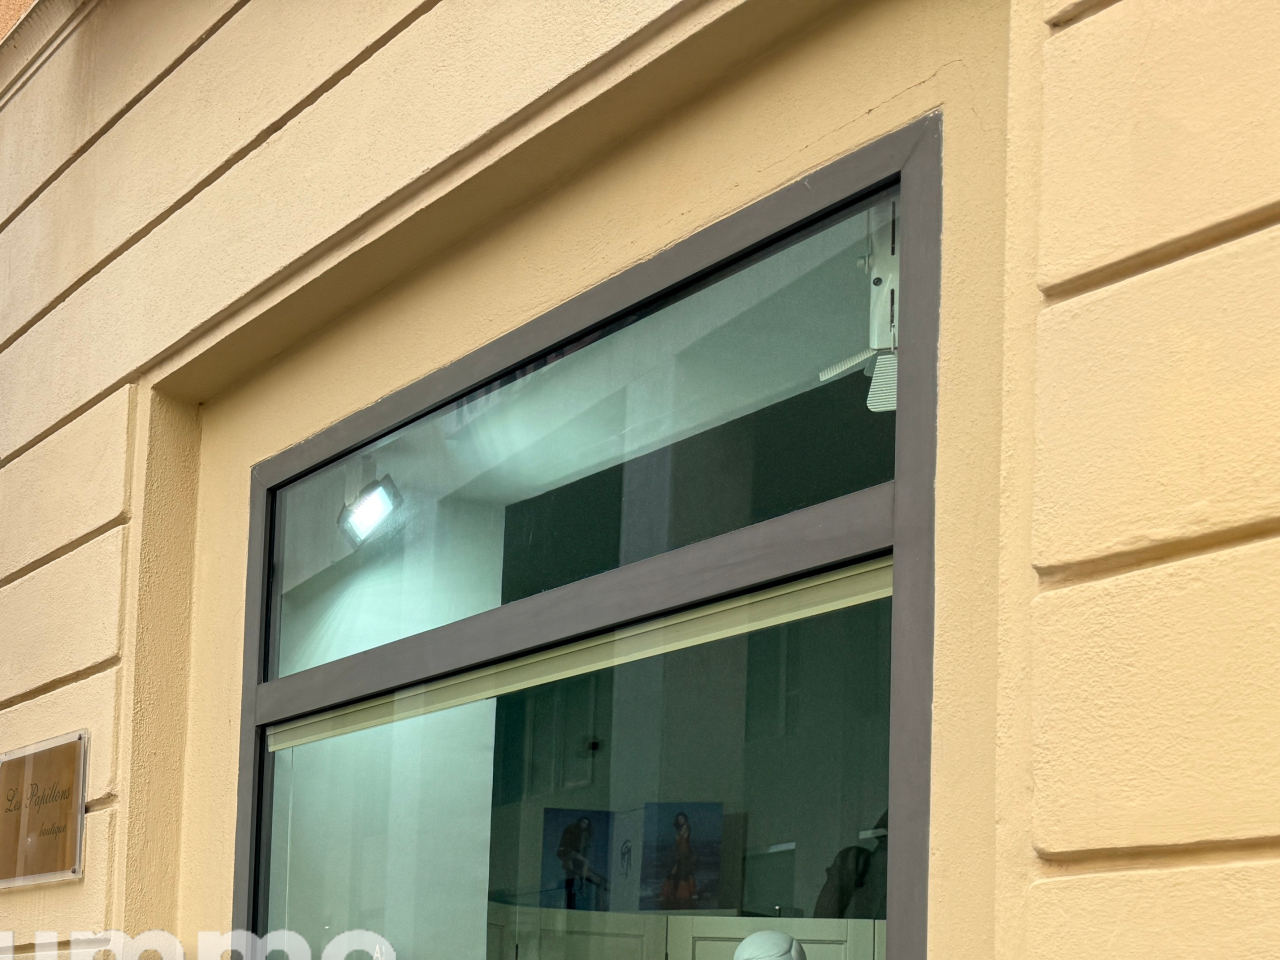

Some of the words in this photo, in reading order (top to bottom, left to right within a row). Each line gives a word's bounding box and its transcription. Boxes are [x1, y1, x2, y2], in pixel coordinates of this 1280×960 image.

[5, 787, 21, 813] Les
[25, 781, 71, 815] Papillons
[39, 821, 67, 841] boutique
